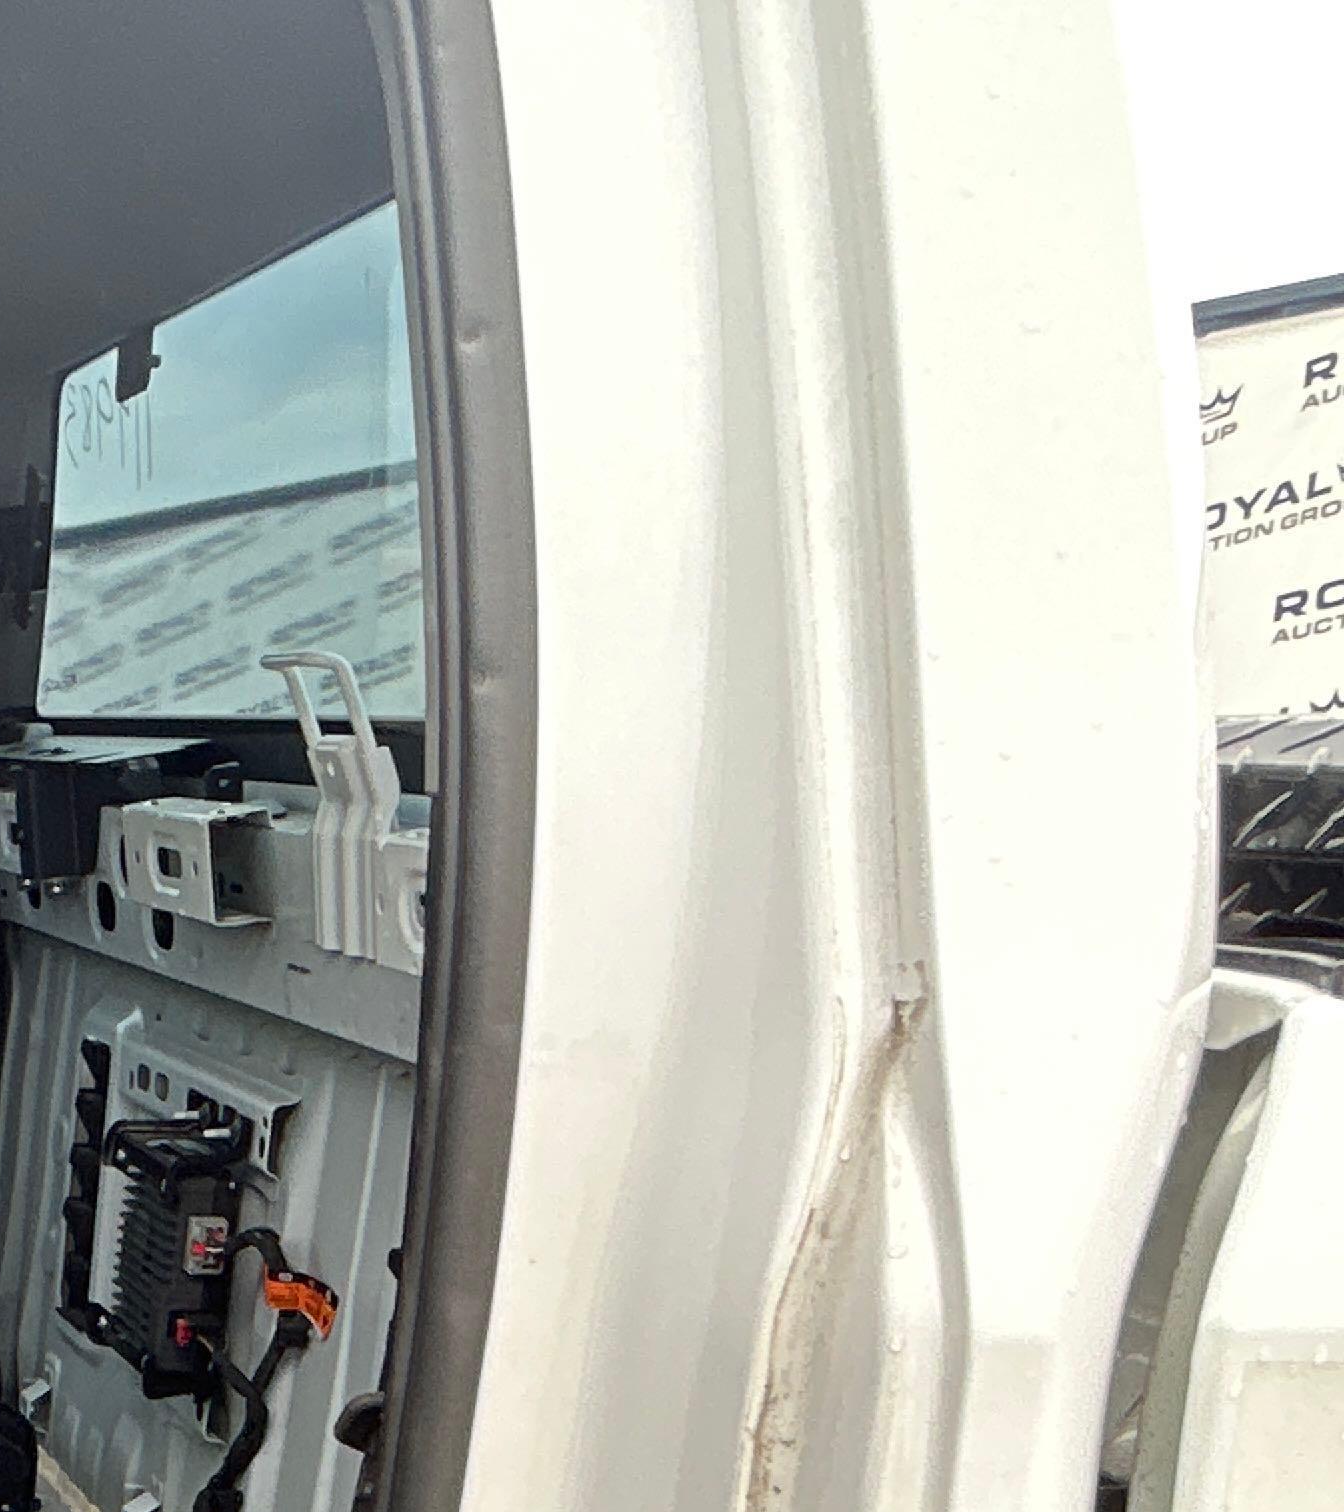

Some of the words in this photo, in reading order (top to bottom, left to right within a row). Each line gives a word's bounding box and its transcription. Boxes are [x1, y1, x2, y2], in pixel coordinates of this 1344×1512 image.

[1205, 463, 1344, 531] OYAL
[1208, 519, 1275, 552] TION
[1279, 497, 1344, 530] GRO
